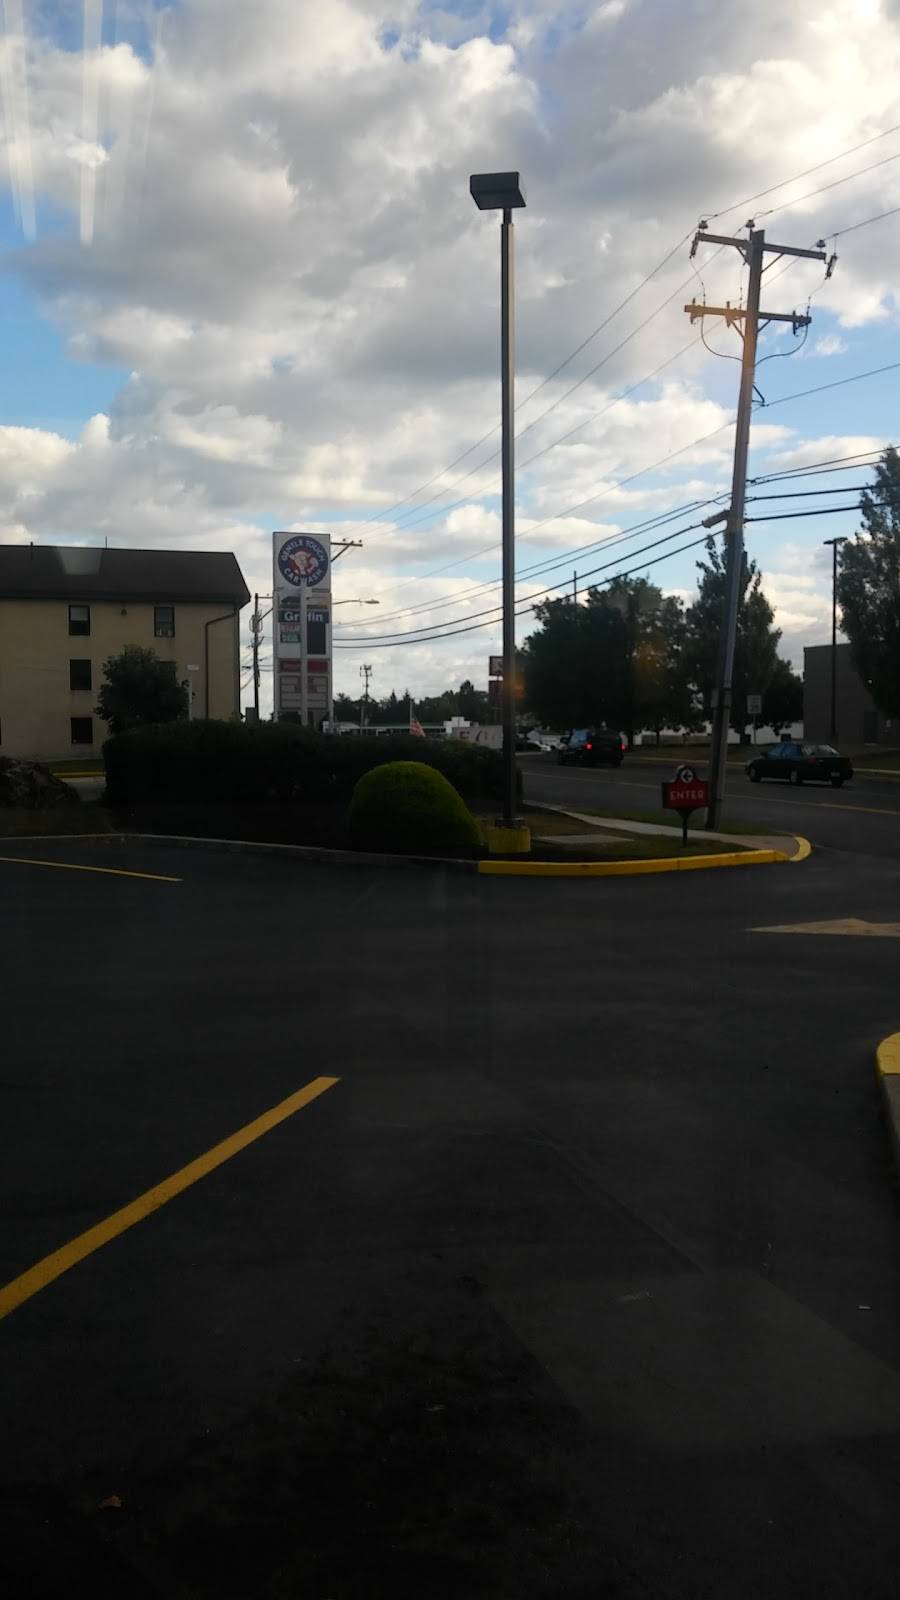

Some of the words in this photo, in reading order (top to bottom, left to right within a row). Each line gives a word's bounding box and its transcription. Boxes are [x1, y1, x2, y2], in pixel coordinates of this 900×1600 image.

[281, 539, 303, 561] GENTLE
[305, 540, 326, 561] TOUCH
[283, 567, 299, 583] CAR
[300, 569, 321, 584] WASH
[284, 611, 323, 622] Grfin
[670, 790, 704, 800] ENTER
